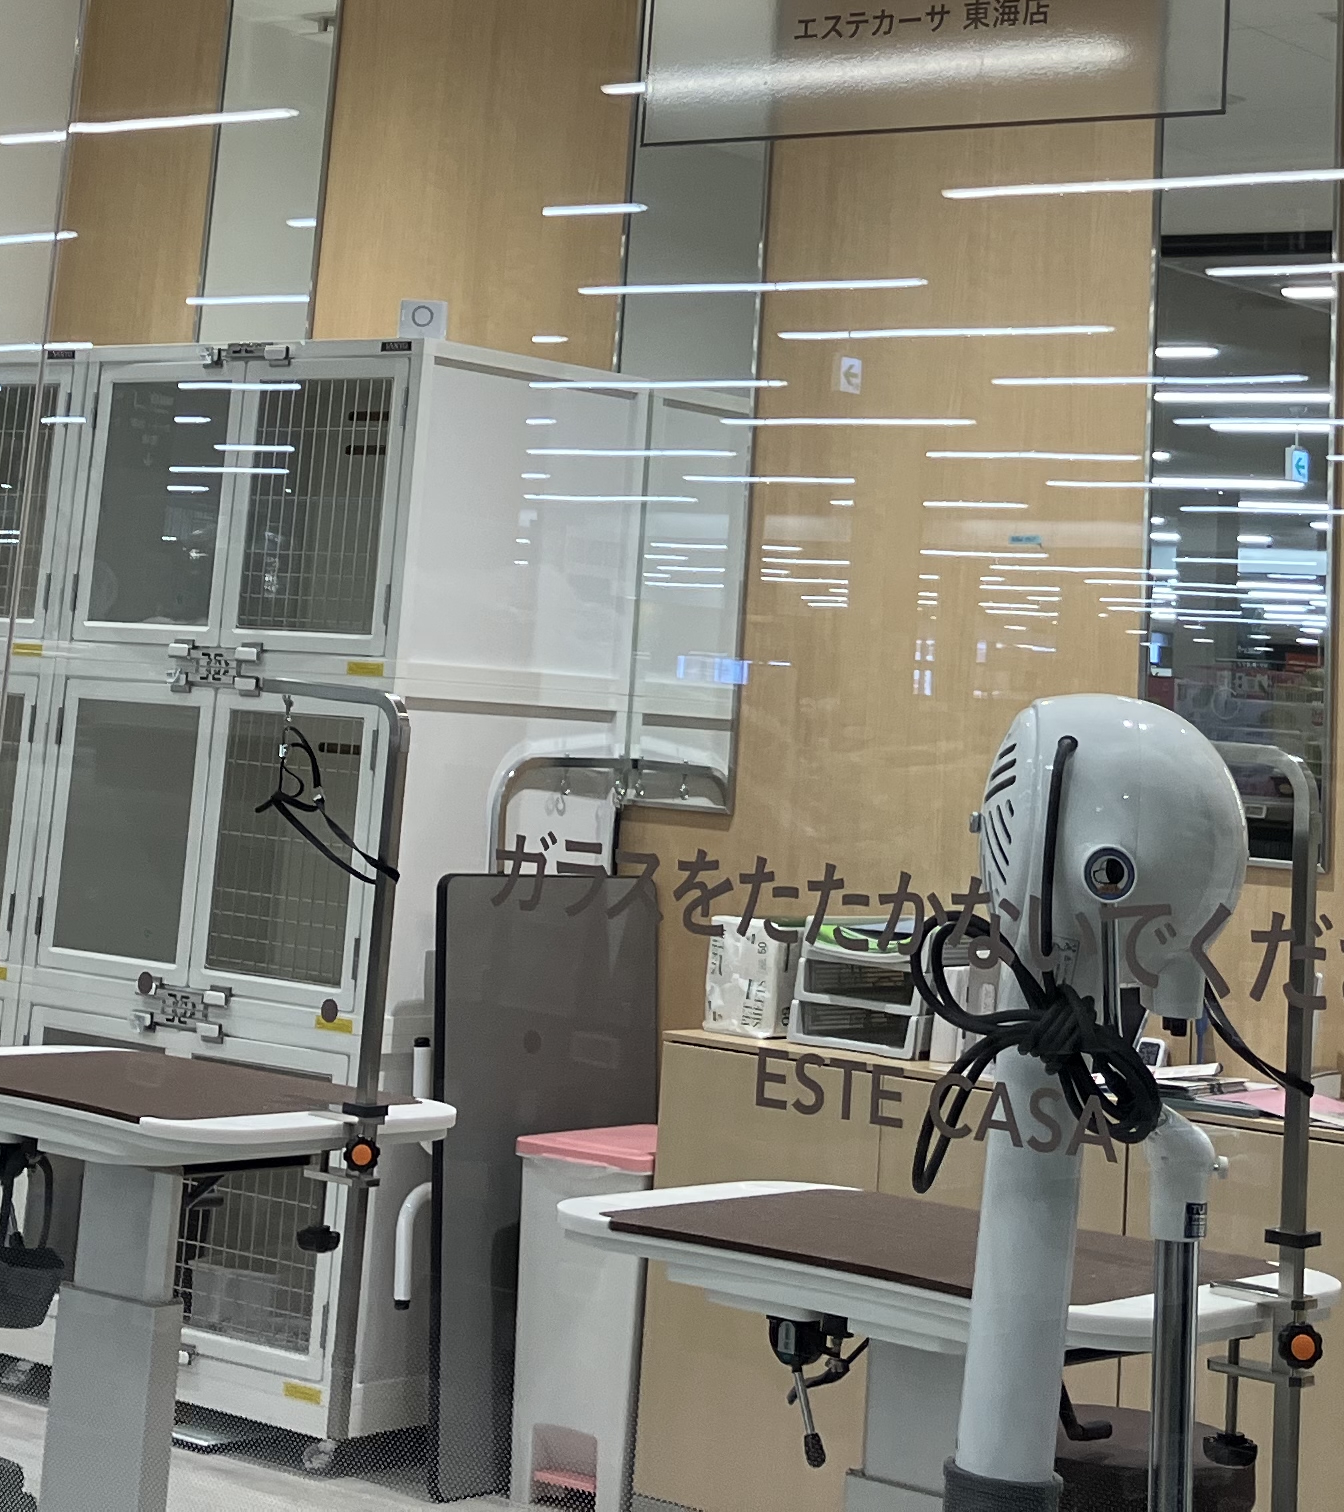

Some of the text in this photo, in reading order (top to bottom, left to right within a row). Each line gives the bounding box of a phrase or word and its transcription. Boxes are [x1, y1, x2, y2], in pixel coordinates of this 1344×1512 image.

[793, 4, 951, 41] エステカーサ
[754, 1053, 1118, 1164] ESTE CASA
